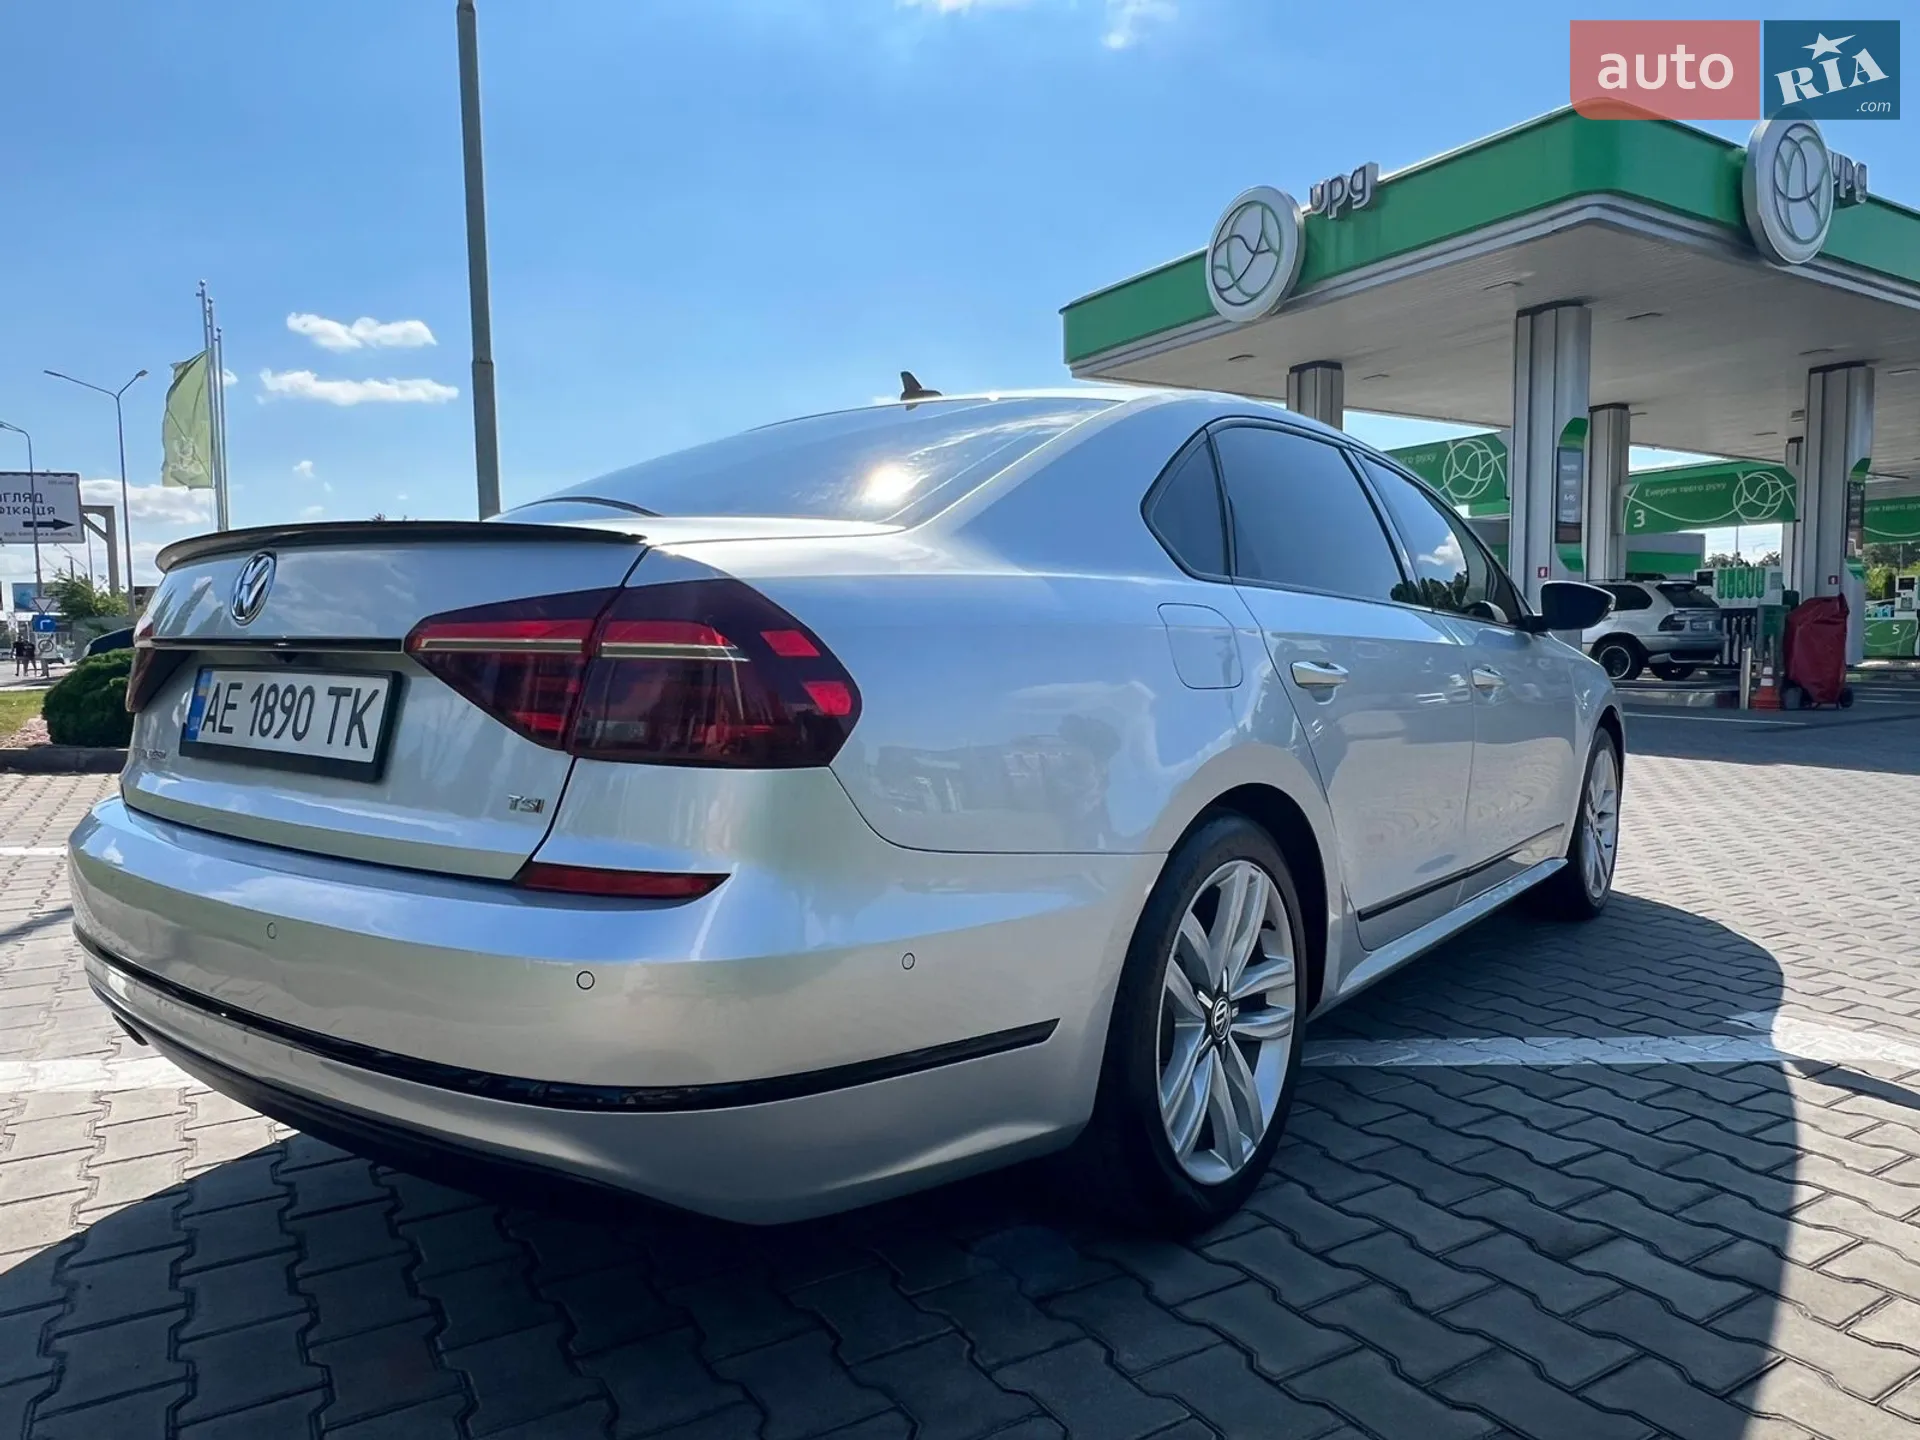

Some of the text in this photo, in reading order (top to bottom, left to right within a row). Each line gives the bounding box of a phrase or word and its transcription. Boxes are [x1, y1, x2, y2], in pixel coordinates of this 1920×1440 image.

[1309, 161, 1379, 220] upg
[0, 492, 43, 504] ГЛЯД
[1633, 509, 1646, 528] 3
[1892, 624, 1900, 635] 5
[201, 682, 380, 749] AE 1890 TK
[508, 794, 545, 814] TSI
